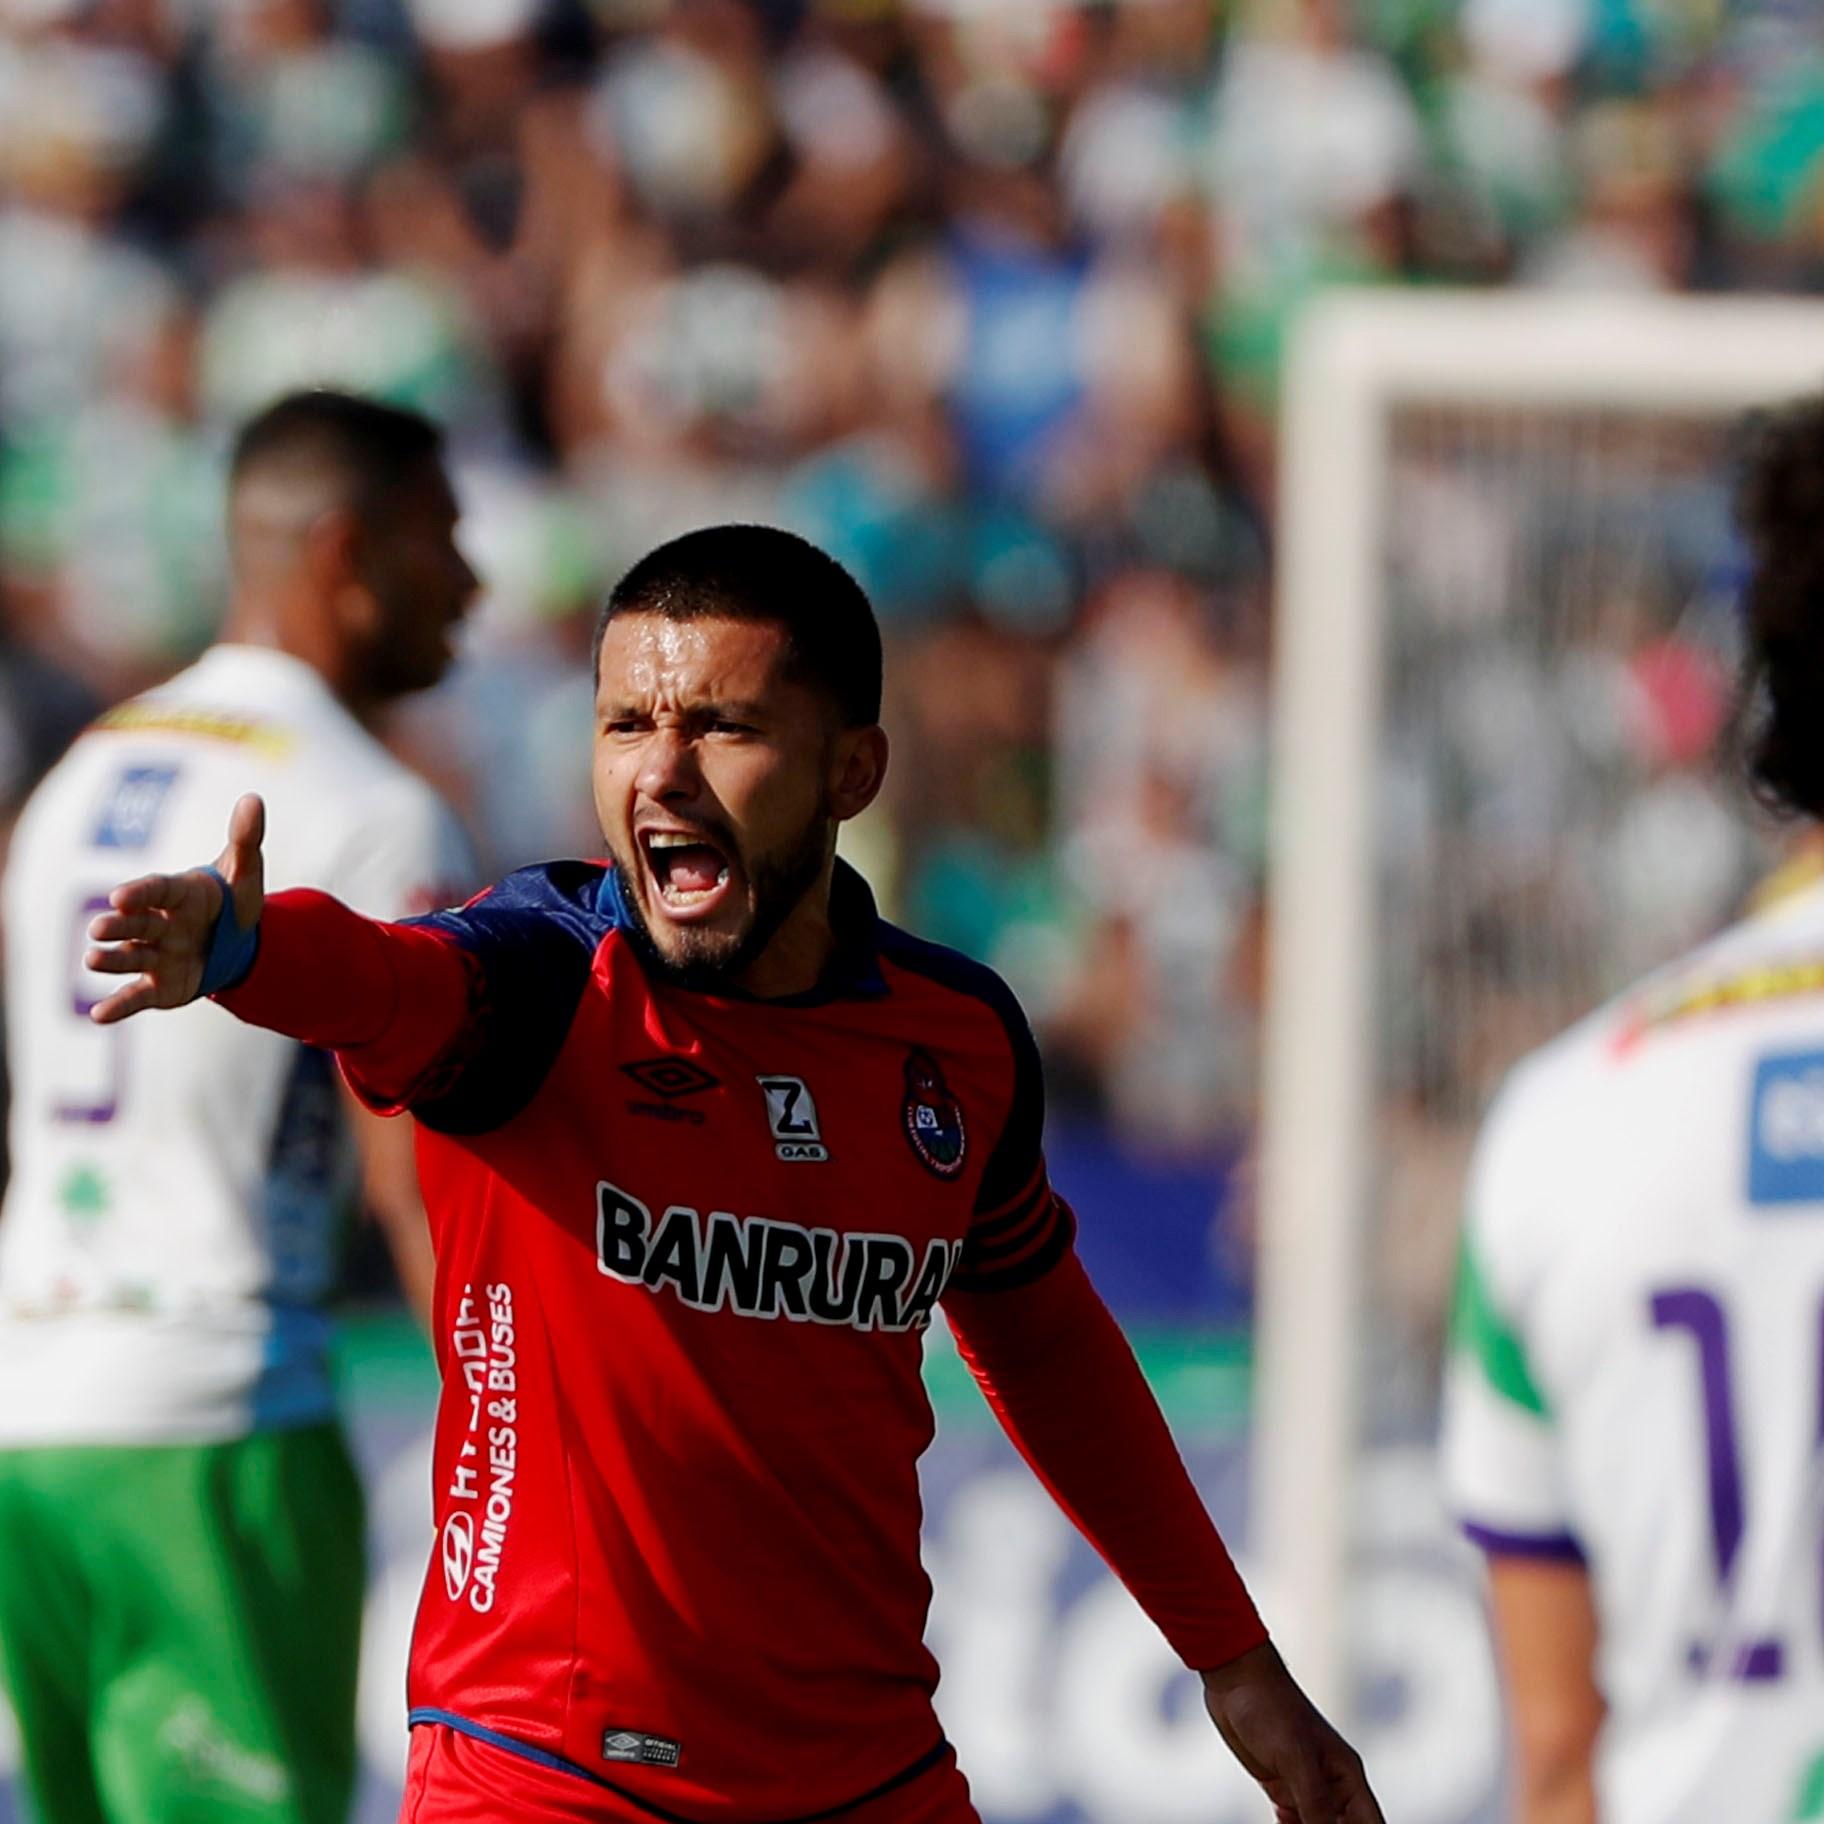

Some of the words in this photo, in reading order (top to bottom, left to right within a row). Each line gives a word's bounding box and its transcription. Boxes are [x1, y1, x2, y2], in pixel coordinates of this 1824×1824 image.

[779, 1145, 822, 1159] GAS
[596, 1180, 964, 1332] BANRURA
[486, 1282, 517, 1393] BUSES
[487, 1396, 517, 1424] &
[470, 1425, 517, 1614] CAMIONES
